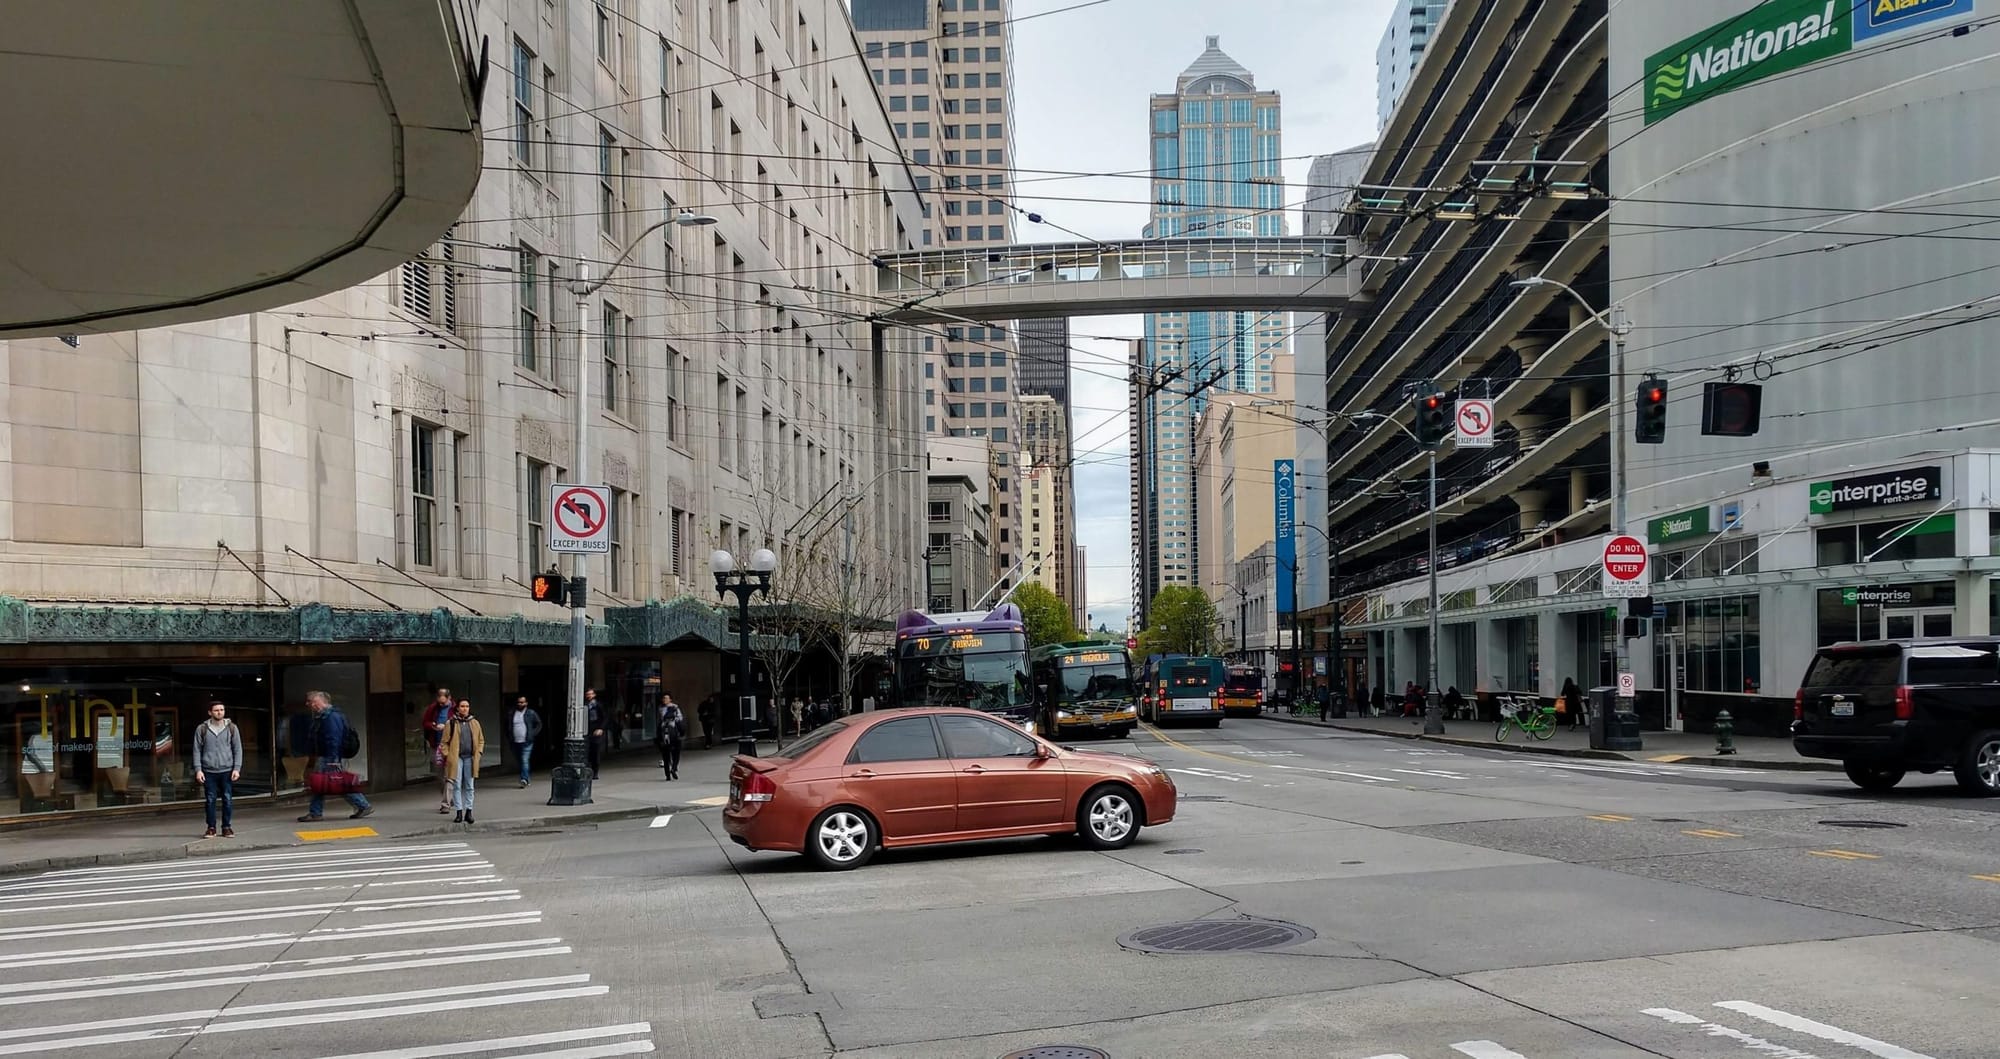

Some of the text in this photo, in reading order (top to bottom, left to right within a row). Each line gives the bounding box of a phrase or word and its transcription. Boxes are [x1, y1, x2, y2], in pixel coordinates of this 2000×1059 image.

[1812, 477, 1928, 505] enterprise
[1883, 492, 1927, 504] rent-a-car
[553, 540, 606, 549] EXCEPT BUSES
[1610, 544, 1640, 553] DO NOT
[1613, 564, 1638, 572] ENTER
[1843, 590, 1911, 602] enterprise
[918, 638, 930, 650] 70
[952, 639, 983, 649] FAIRVIEW
[25, 687, 146, 739] Tint
[52, 743, 59, 753] of
[61, 742, 94, 753] makeup
